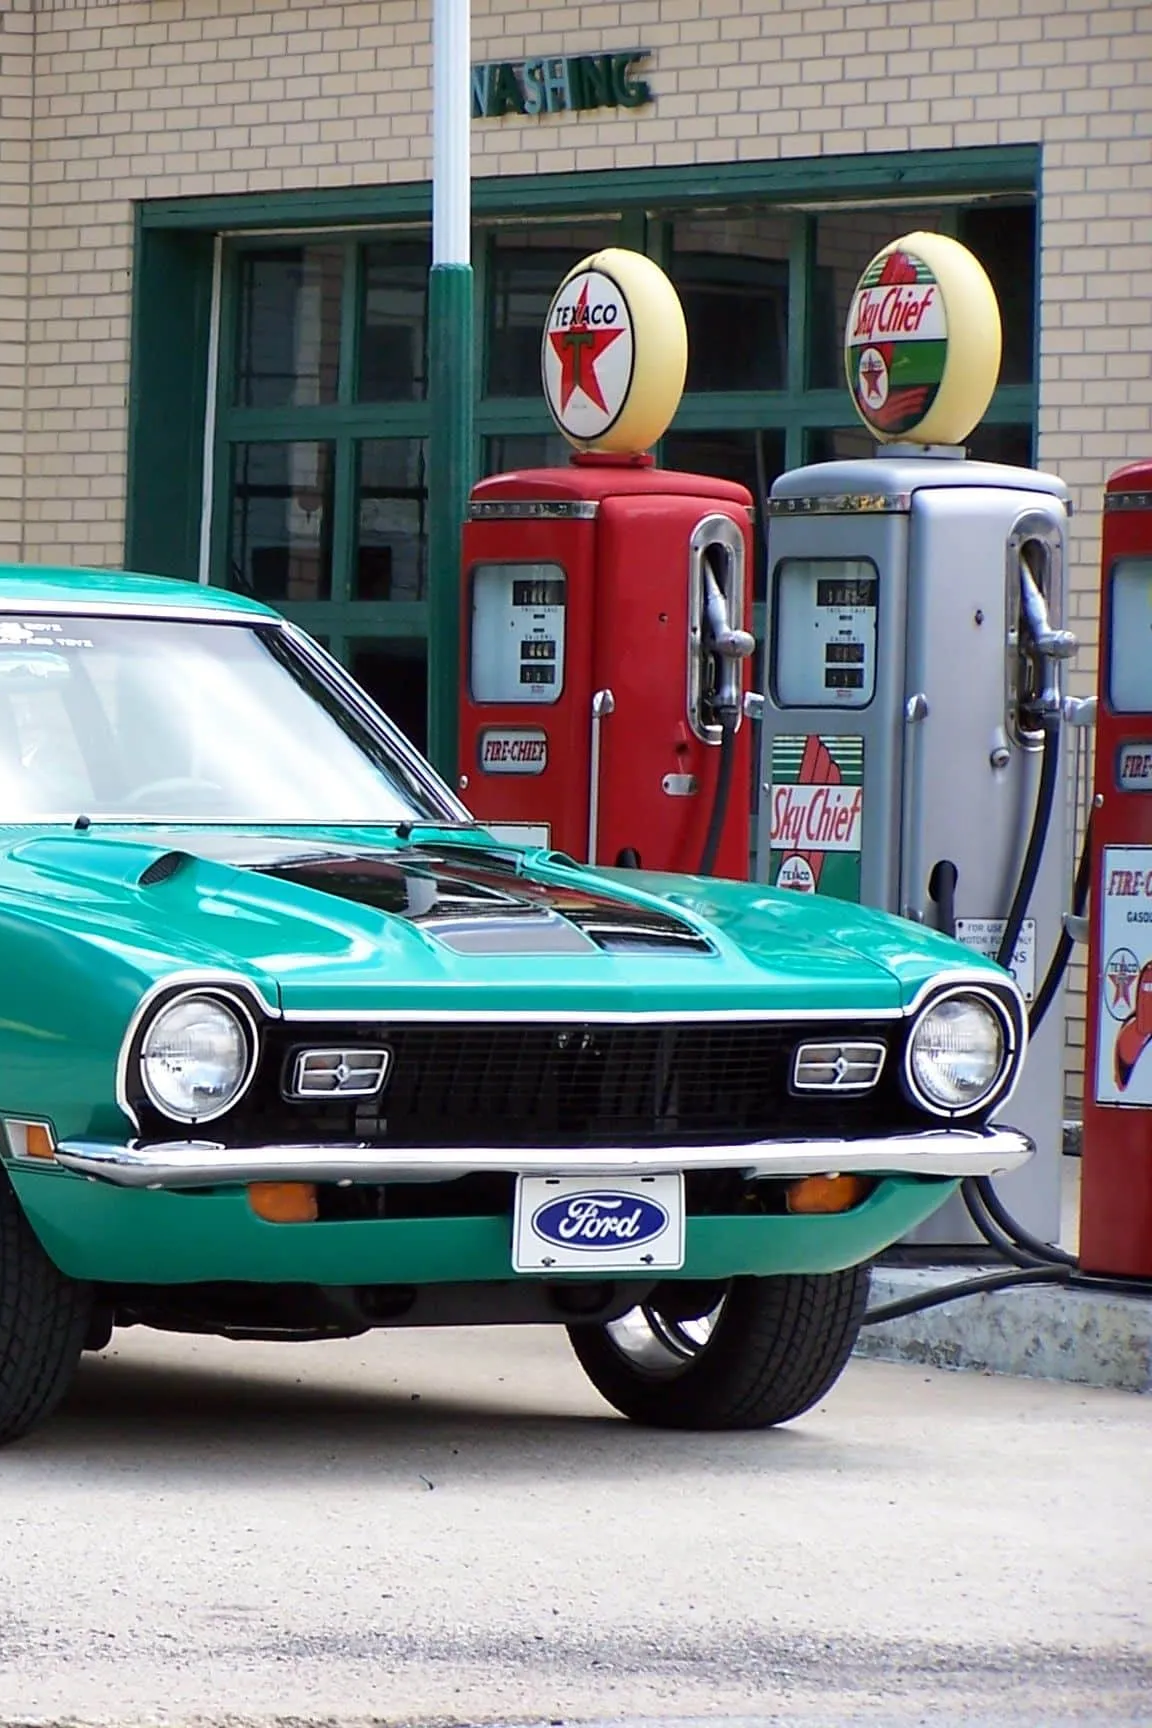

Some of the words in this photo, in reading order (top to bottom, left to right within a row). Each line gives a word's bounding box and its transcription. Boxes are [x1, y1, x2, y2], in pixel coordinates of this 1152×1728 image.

[555, 303, 618, 328] TEXACO
[878, 287, 935, 333] Chief
[563, 333, 594, 386] T
[484, 740, 545, 761] FIRE-CHIEF
[805, 788, 862, 842] Chief
[558, 1199, 642, 1239] Ford
